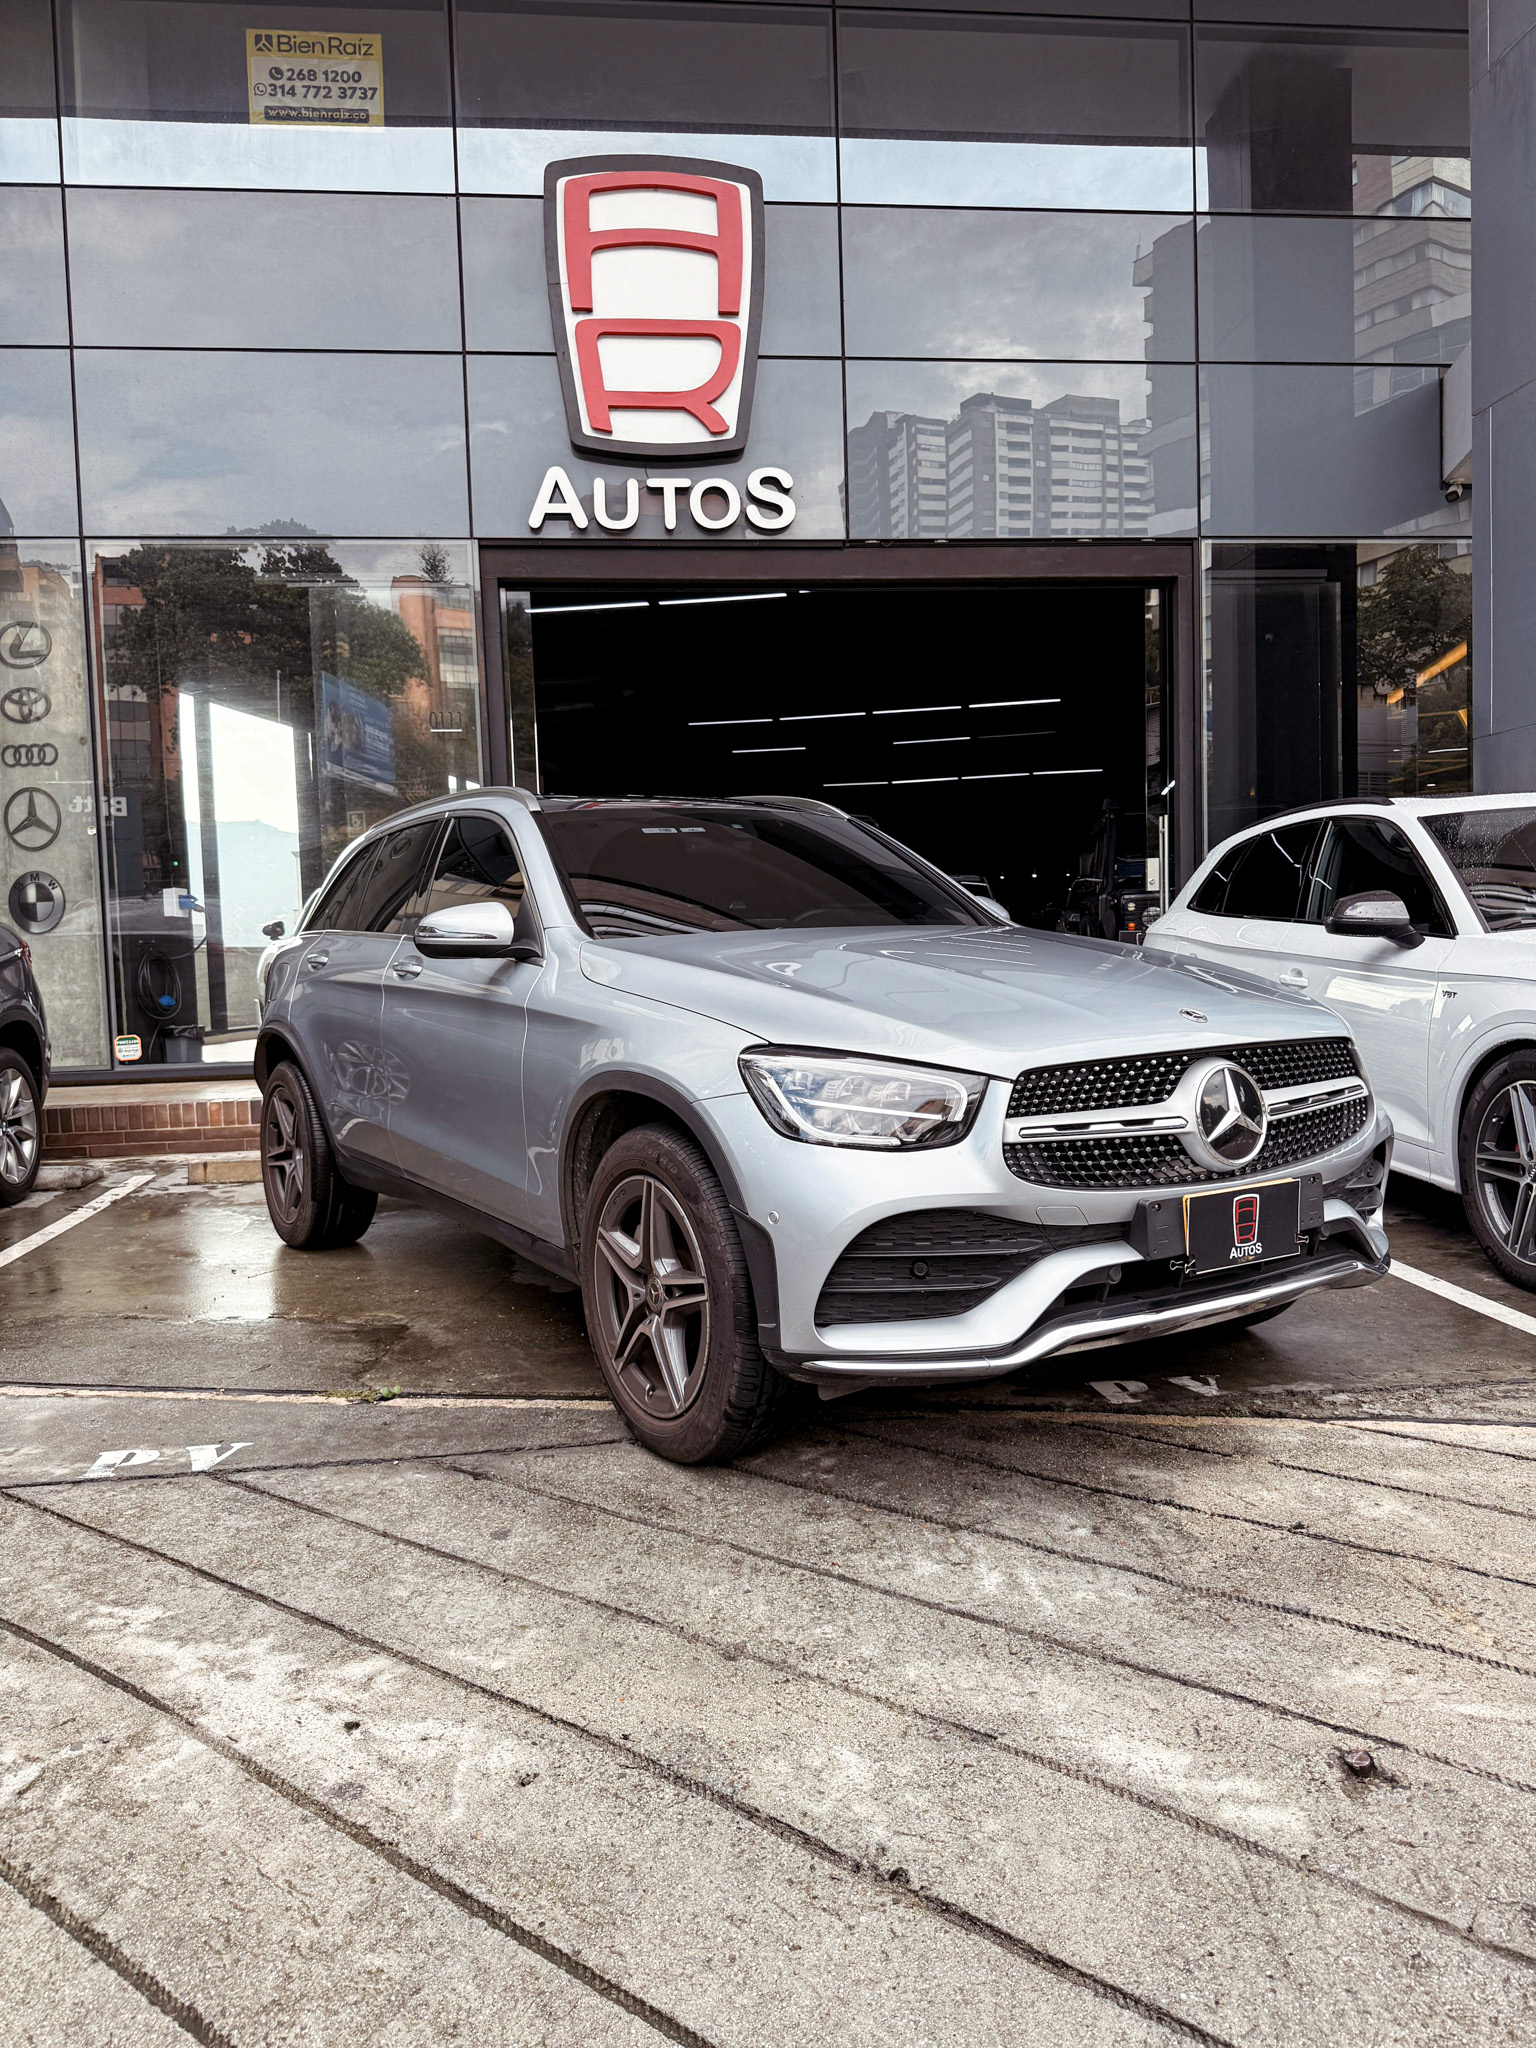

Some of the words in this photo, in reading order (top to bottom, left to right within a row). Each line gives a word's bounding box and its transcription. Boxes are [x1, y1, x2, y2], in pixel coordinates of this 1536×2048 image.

[277, 34, 325, 54] Bien
[328, 38, 374, 56] Raíz
[286, 68, 318, 82] 268
[322, 70, 362, 83] 1200
[268, 83, 297, 98] 314
[301, 85, 332, 99] 772
[337, 86, 378, 100] 3737
[267, 107, 367, 120] www.bienraiz.co
[528, 466, 796, 530] AUTOS
[1229, 1242, 1263, 1260] AUTOS
[78, 1450, 162, 1479] P
[185, 1442, 254, 1472] V
